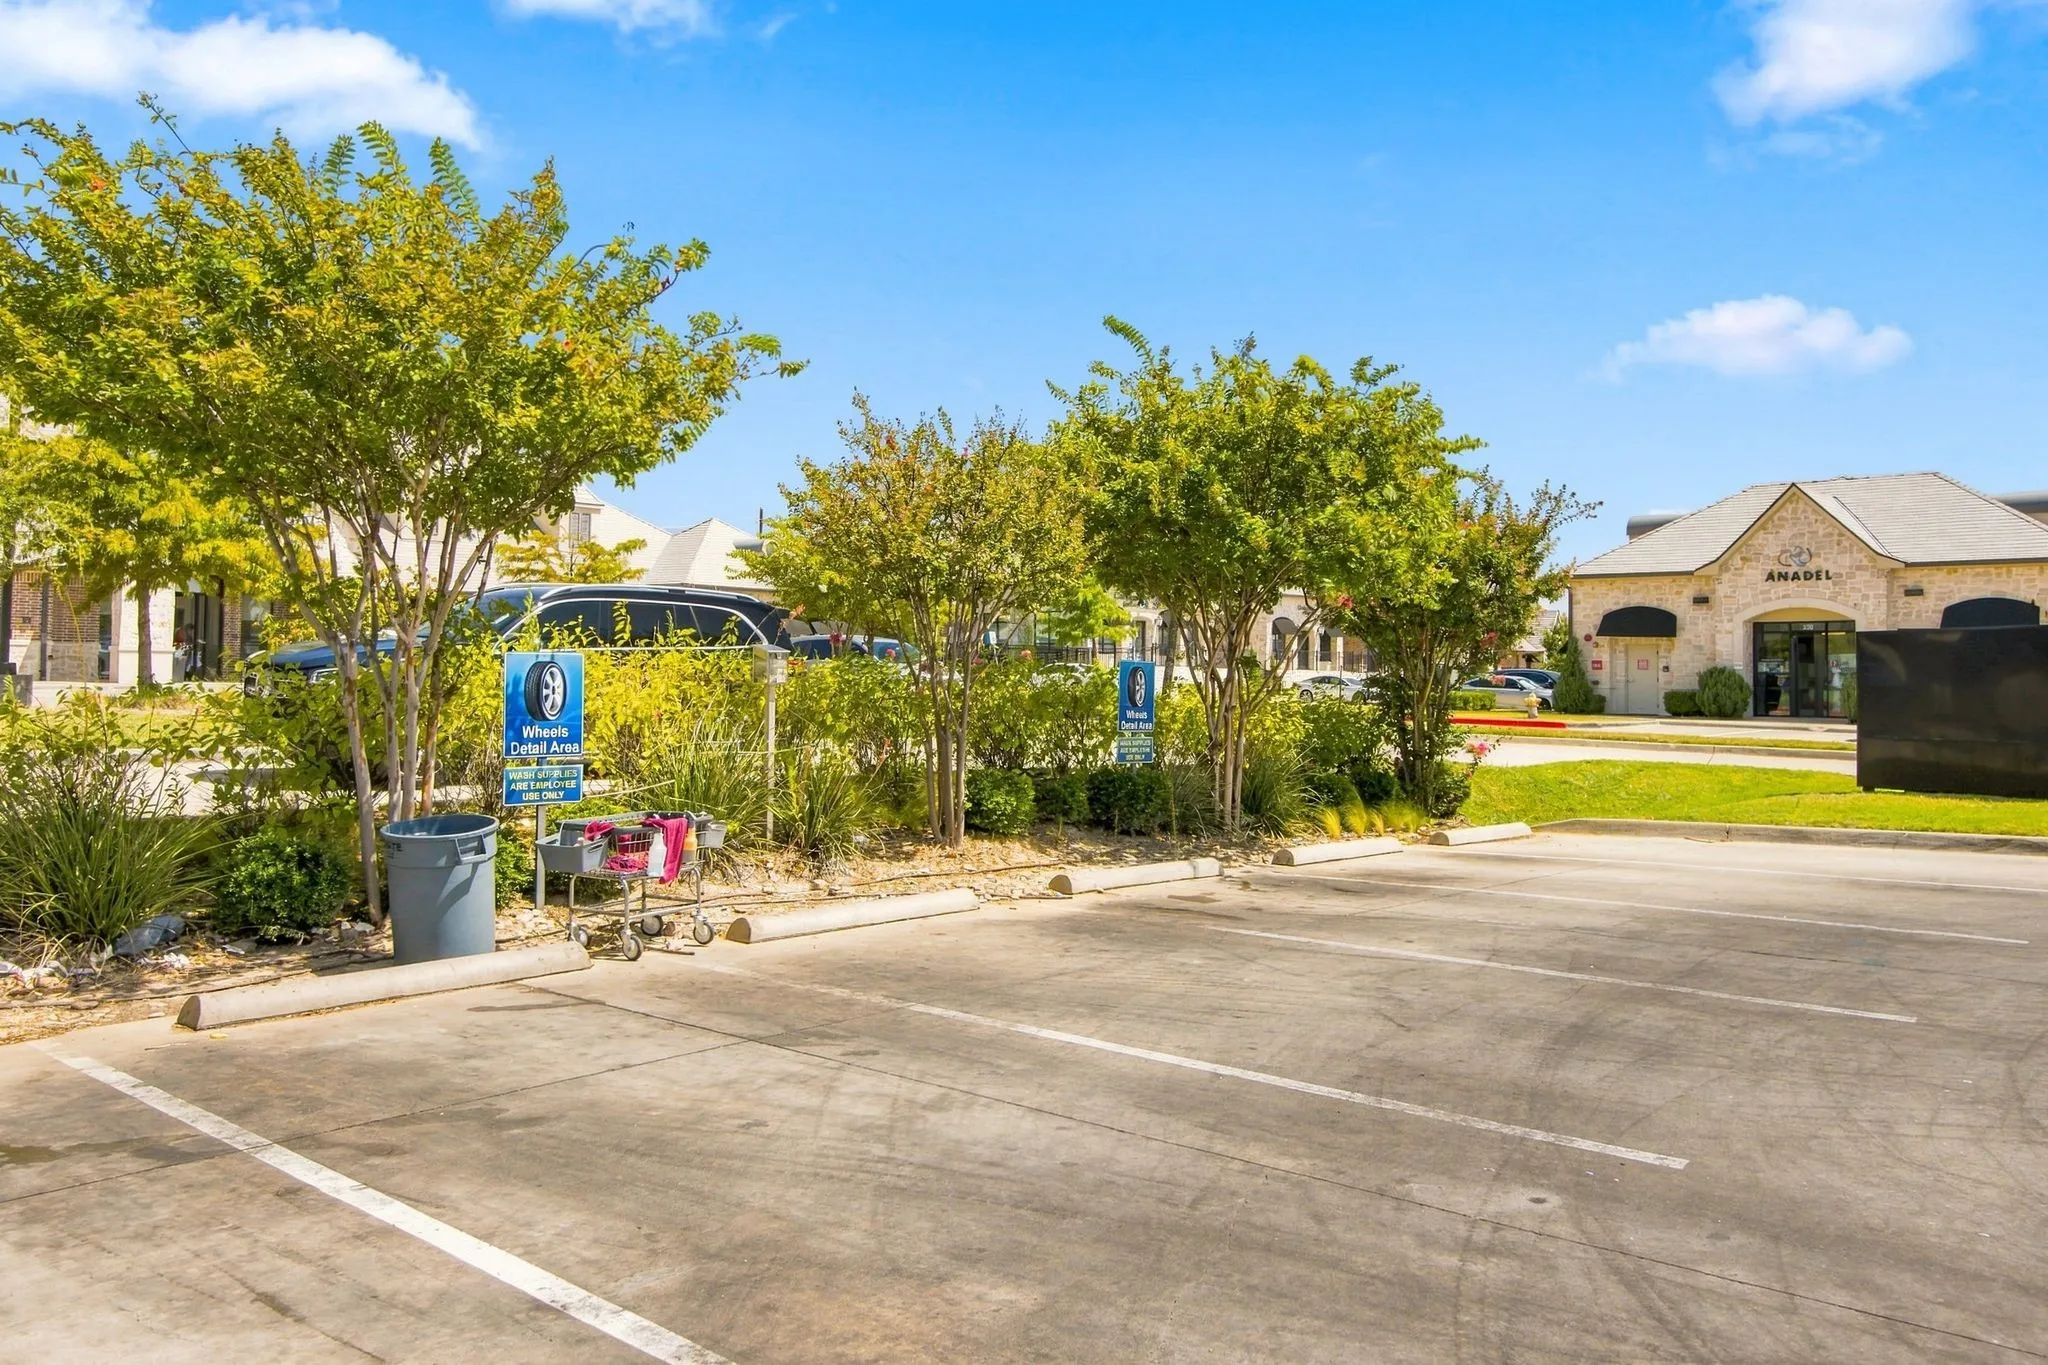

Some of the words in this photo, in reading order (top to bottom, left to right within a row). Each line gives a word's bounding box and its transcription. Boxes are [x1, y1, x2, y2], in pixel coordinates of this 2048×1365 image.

[1765, 569, 1833, 582] ANADEL
[522, 725, 569, 738] Wheels
[1120, 721, 1138, 730] Detail
[1138, 721, 1153, 730] Area
[510, 741, 547, 755] Detail
[550, 741, 579, 754] Area
[509, 771, 535, 780] WASH
[537, 769, 578, 780] SUPPLIES
[509, 782, 529, 791] ARE
[530, 779, 577, 790] EMPLOYEE
[522, 792, 540, 801] USE
[541, 790, 565, 800] ONLY
